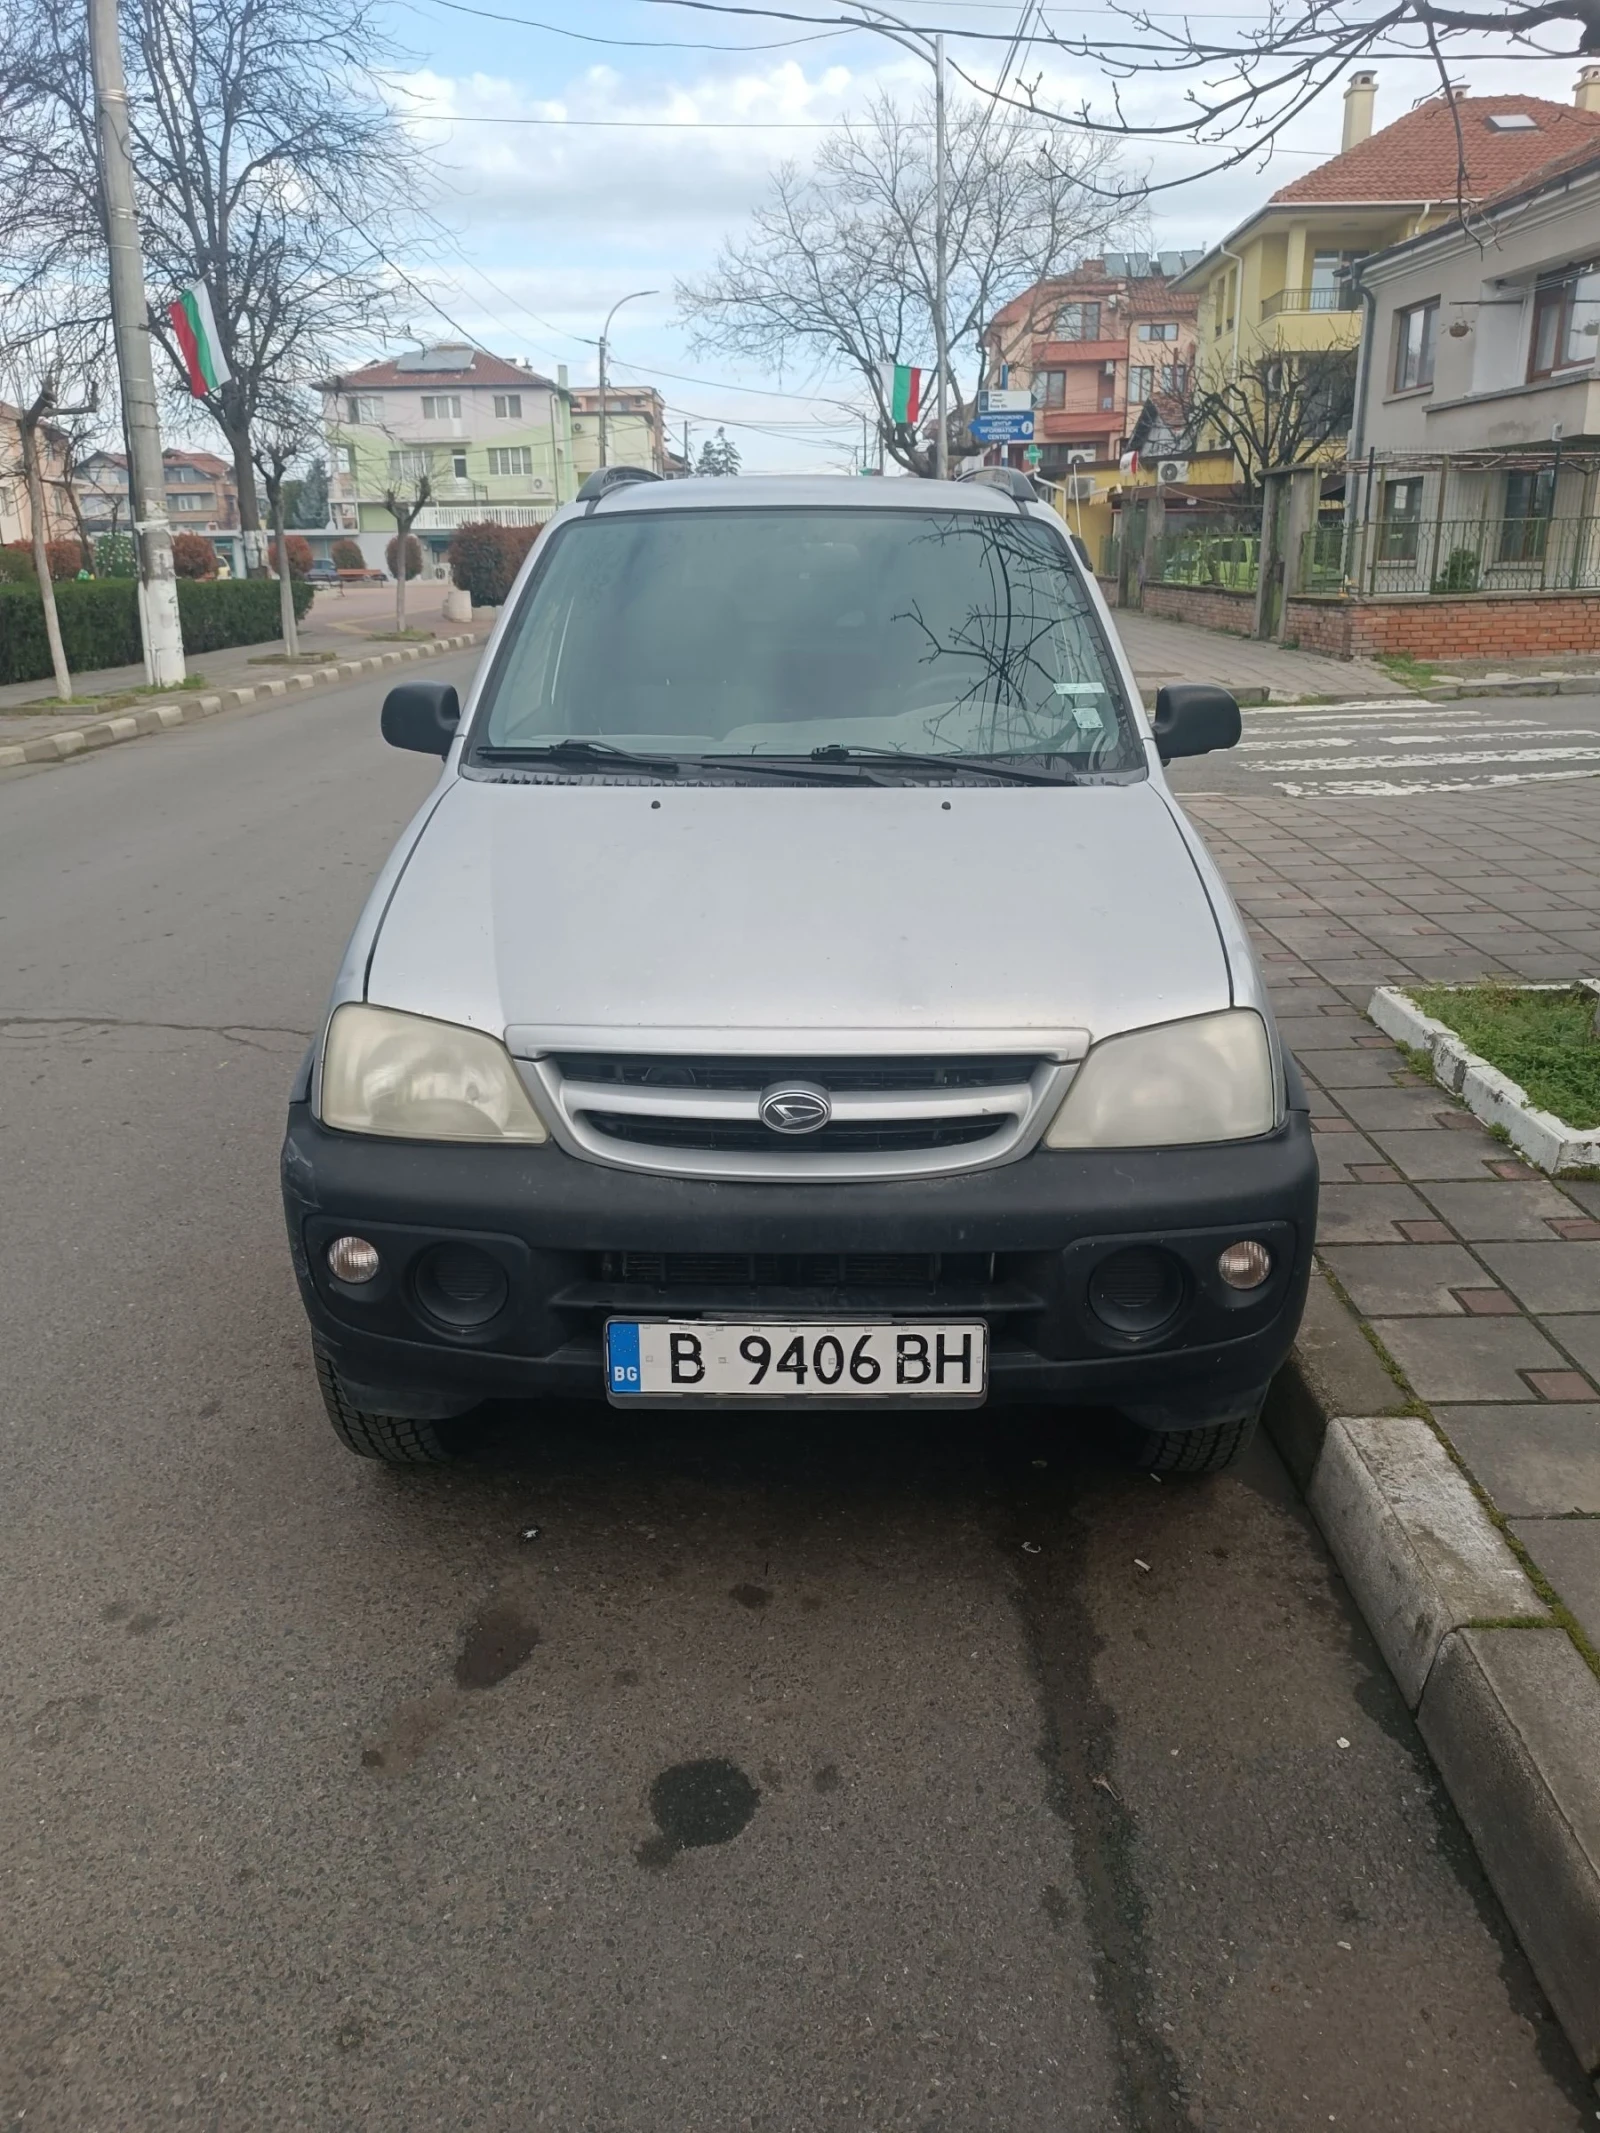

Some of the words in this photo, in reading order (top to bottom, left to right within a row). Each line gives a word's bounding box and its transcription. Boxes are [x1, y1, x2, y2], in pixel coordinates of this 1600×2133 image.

[614, 1366, 638, 1382] BG
[669, 1333, 706, 1383] B
[739, 1335, 881, 1385] 9406
[896, 1333, 971, 1384] BH
